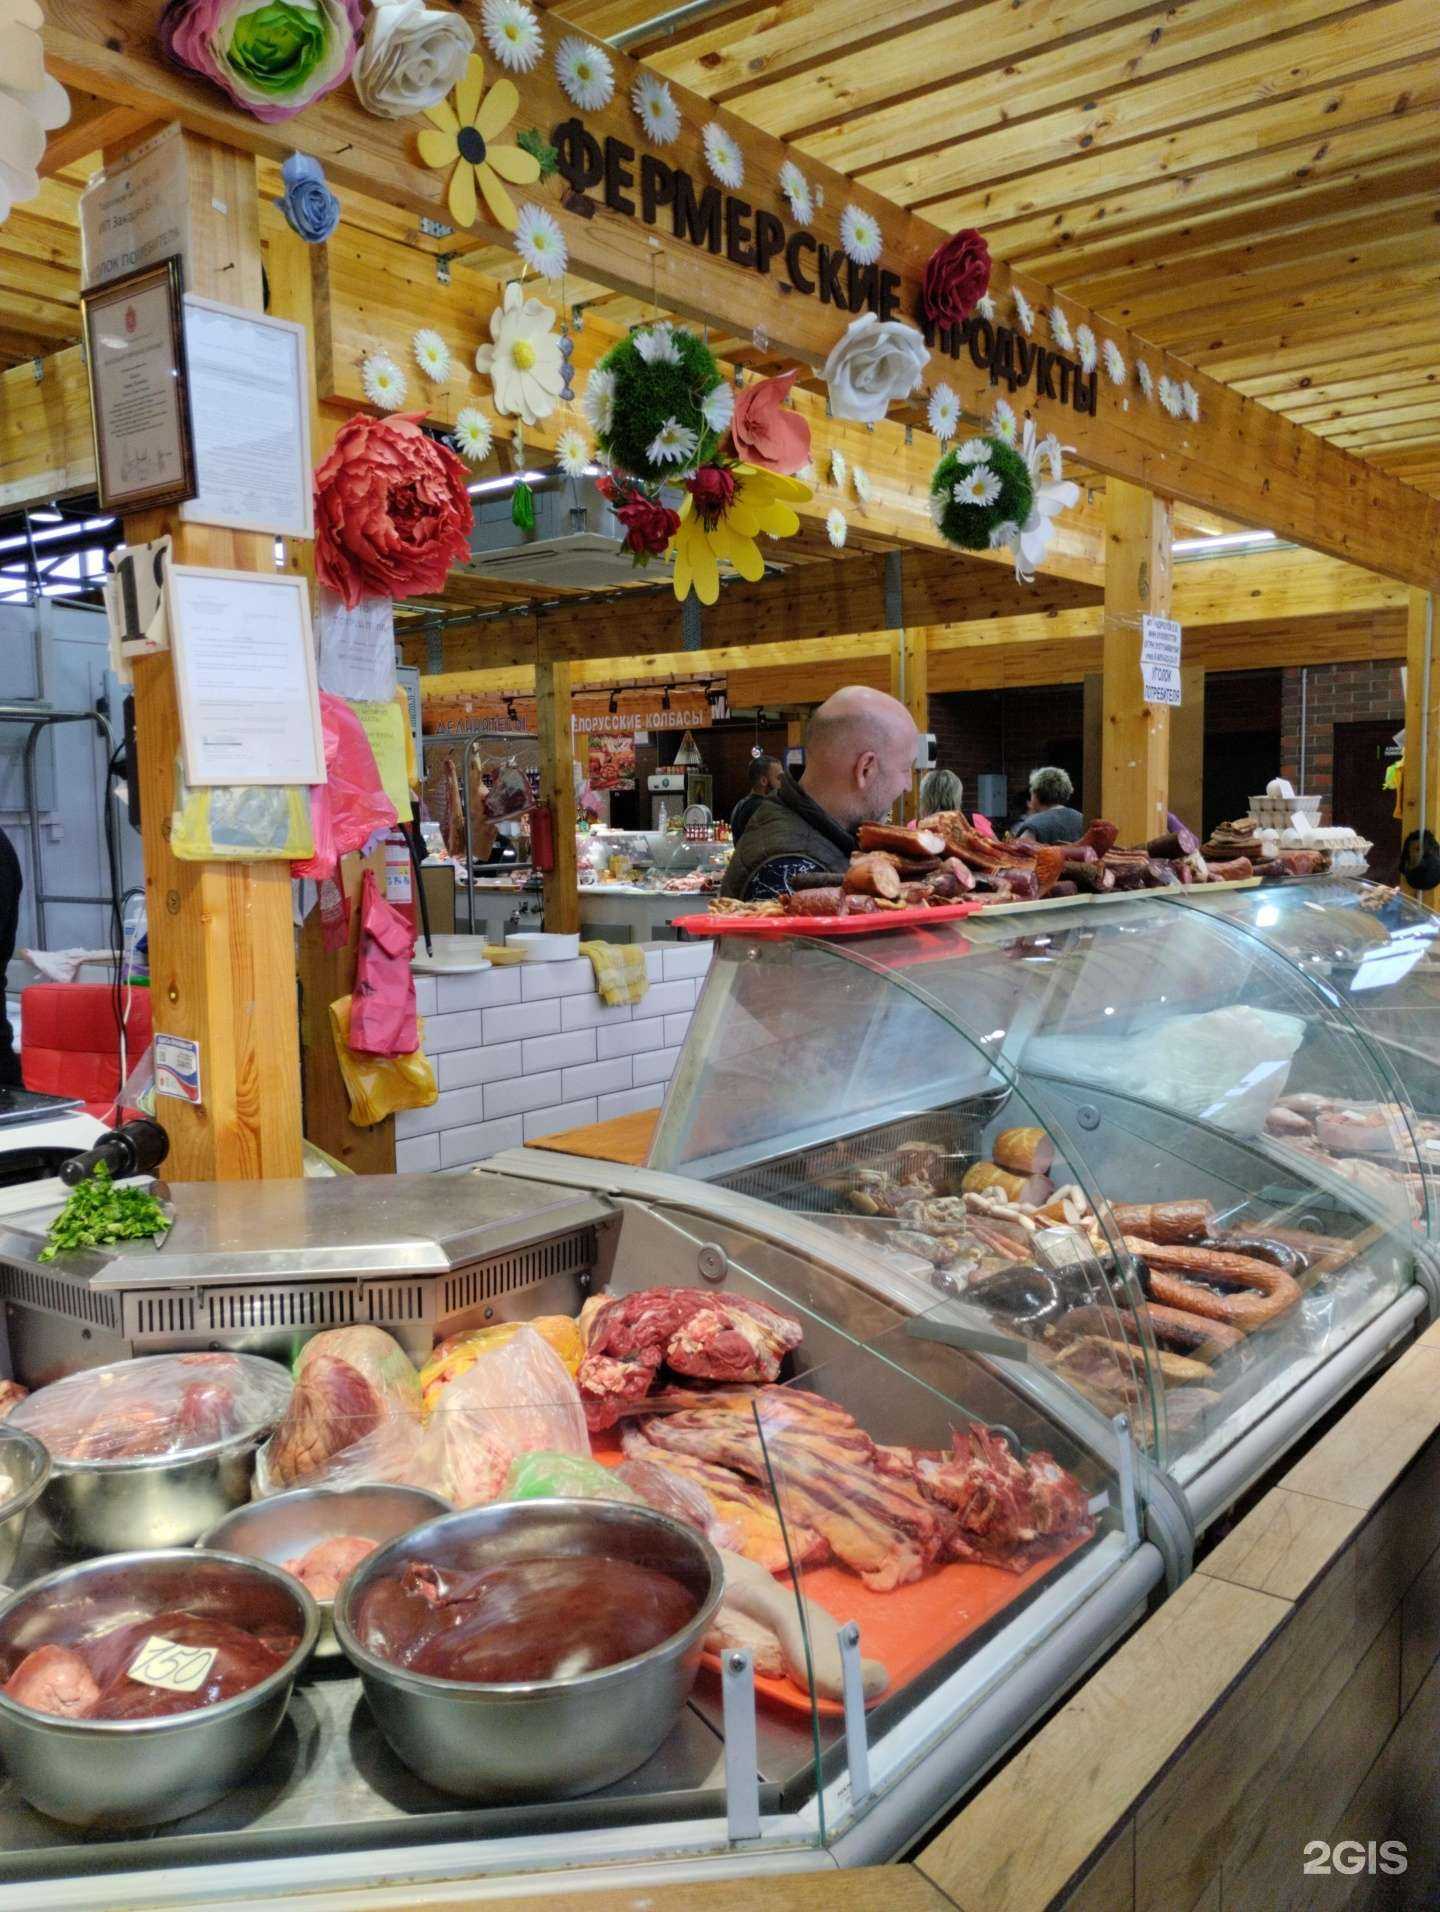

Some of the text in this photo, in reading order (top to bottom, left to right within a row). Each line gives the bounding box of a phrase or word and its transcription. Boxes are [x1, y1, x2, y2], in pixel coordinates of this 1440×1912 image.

[553, 117, 902, 323] ФЕРМЕРСКИЕ
[574, 709, 704, 733] ЕЛОРУССКИЕ КОЛБАСЫ
